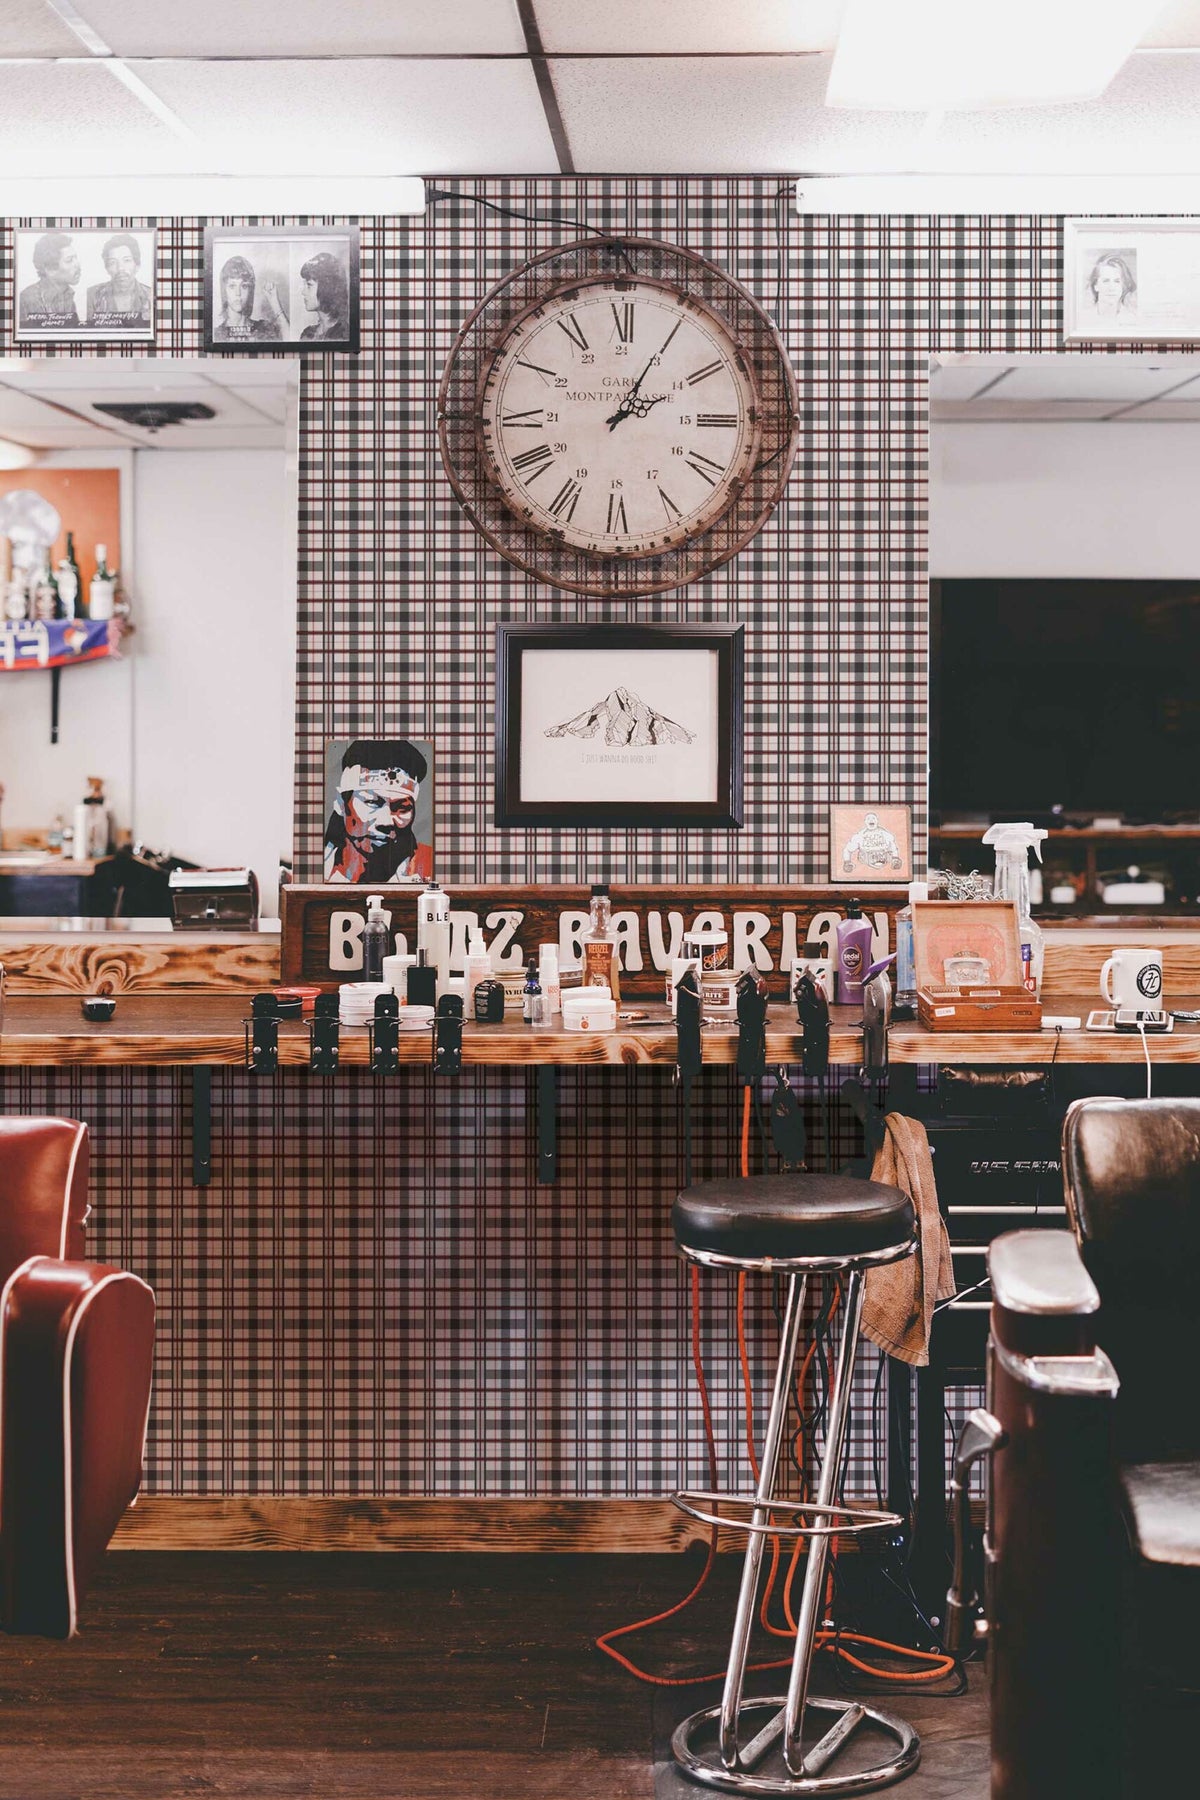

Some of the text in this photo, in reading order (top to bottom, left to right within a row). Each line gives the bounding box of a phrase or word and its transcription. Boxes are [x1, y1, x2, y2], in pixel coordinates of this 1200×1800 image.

[615, 345, 628, 356] 24
[581, 354, 595, 364] 23
[554, 378, 568, 388] 22
[672, 381, 684, 390] 14
[546, 412, 559, 422] 21
[679, 415, 691, 425] 15
[554, 443, 567, 453] 20
[671, 446, 683, 456] 16
[576, 468, 588, 478] 19
[646, 470, 659, 479] 17
[610, 479, 623, 489] 18
[329, 911, 524, 972] BTZ
